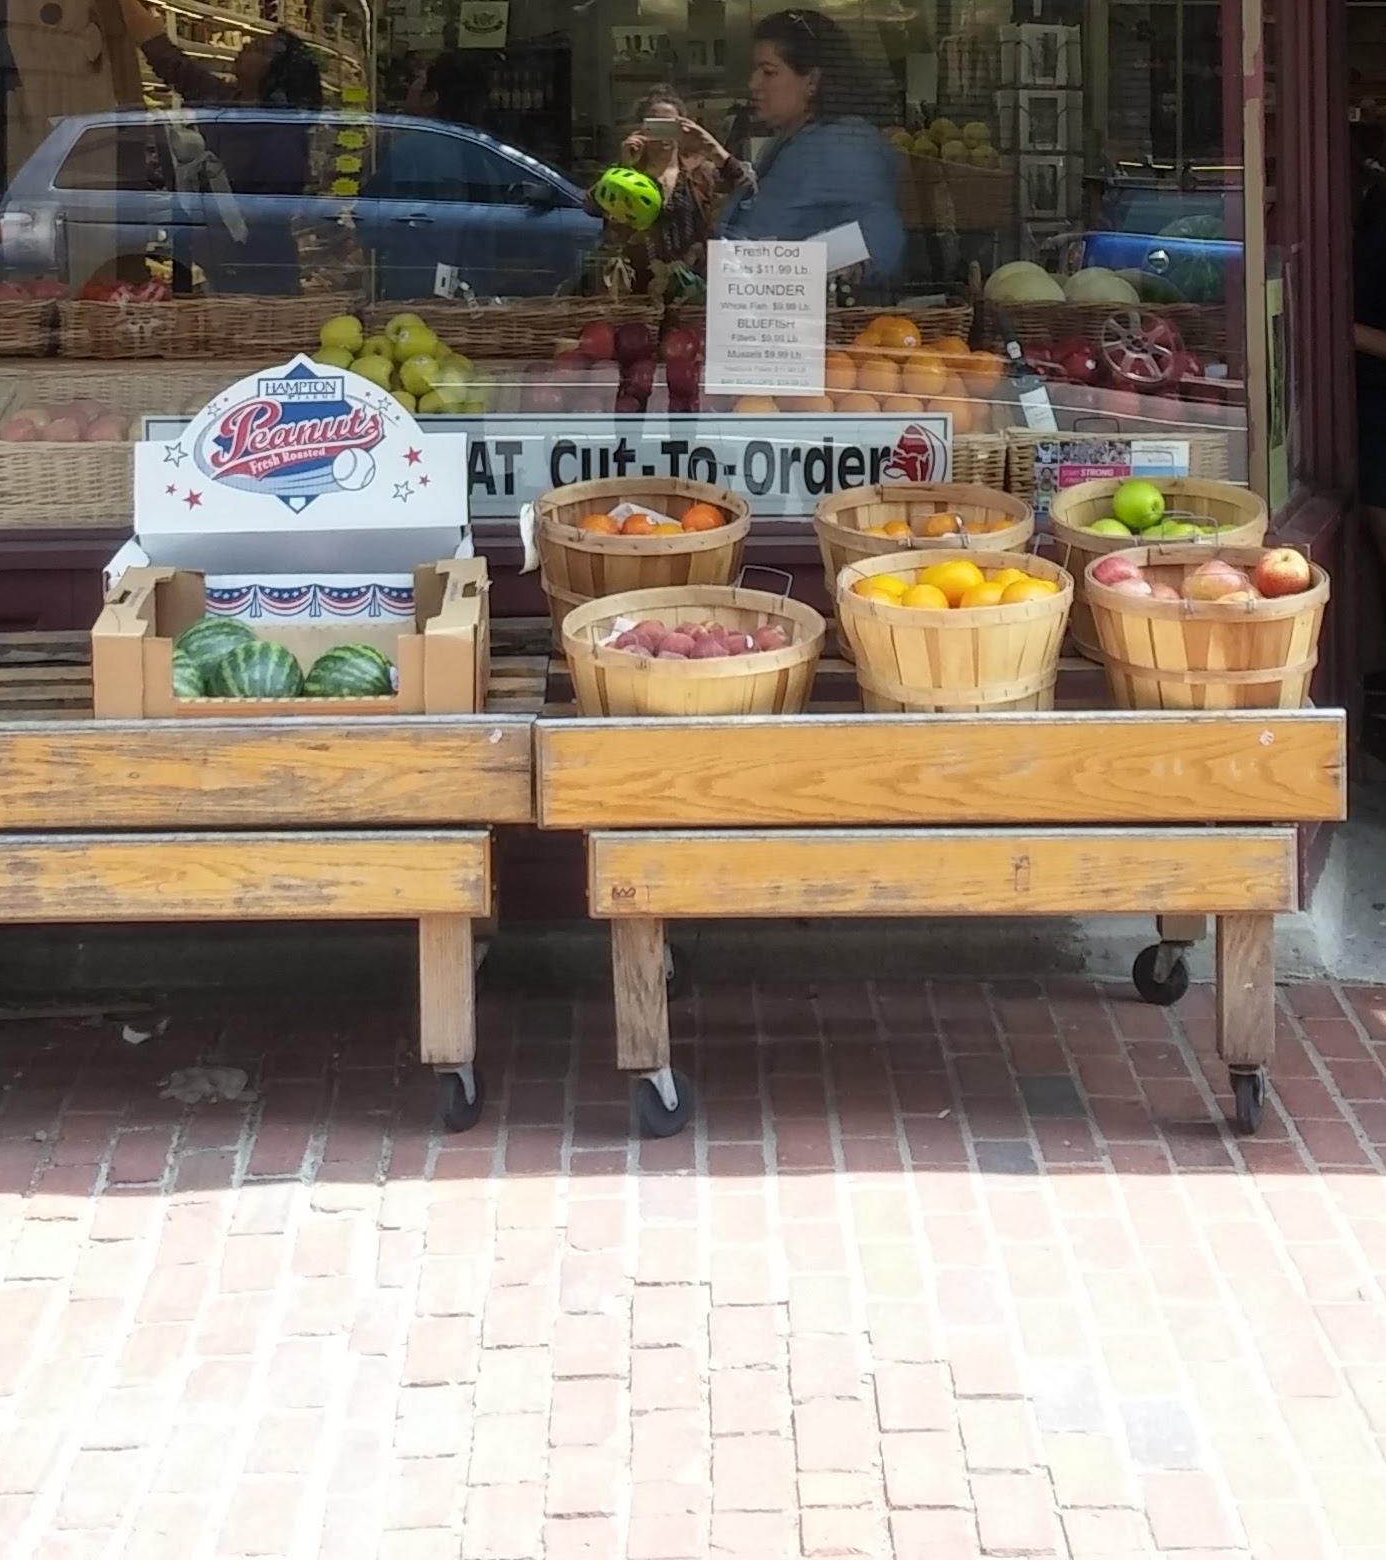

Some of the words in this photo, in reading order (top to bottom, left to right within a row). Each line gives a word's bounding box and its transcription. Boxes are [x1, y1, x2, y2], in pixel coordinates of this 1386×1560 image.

[734, 245, 770, 257] Fresh
[774, 245, 800, 258] Cod
[728, 283, 805, 297] FLOUNDER
[737, 318, 795, 329] BLUEFISH
[266, 380, 336, 394] HAMPTON
[211, 400, 384, 468] Peanuts
[250, 455, 280, 475] Fresh
[282, 447, 325, 463] Roasted
[1080, 468, 1114, 477] STRONG
